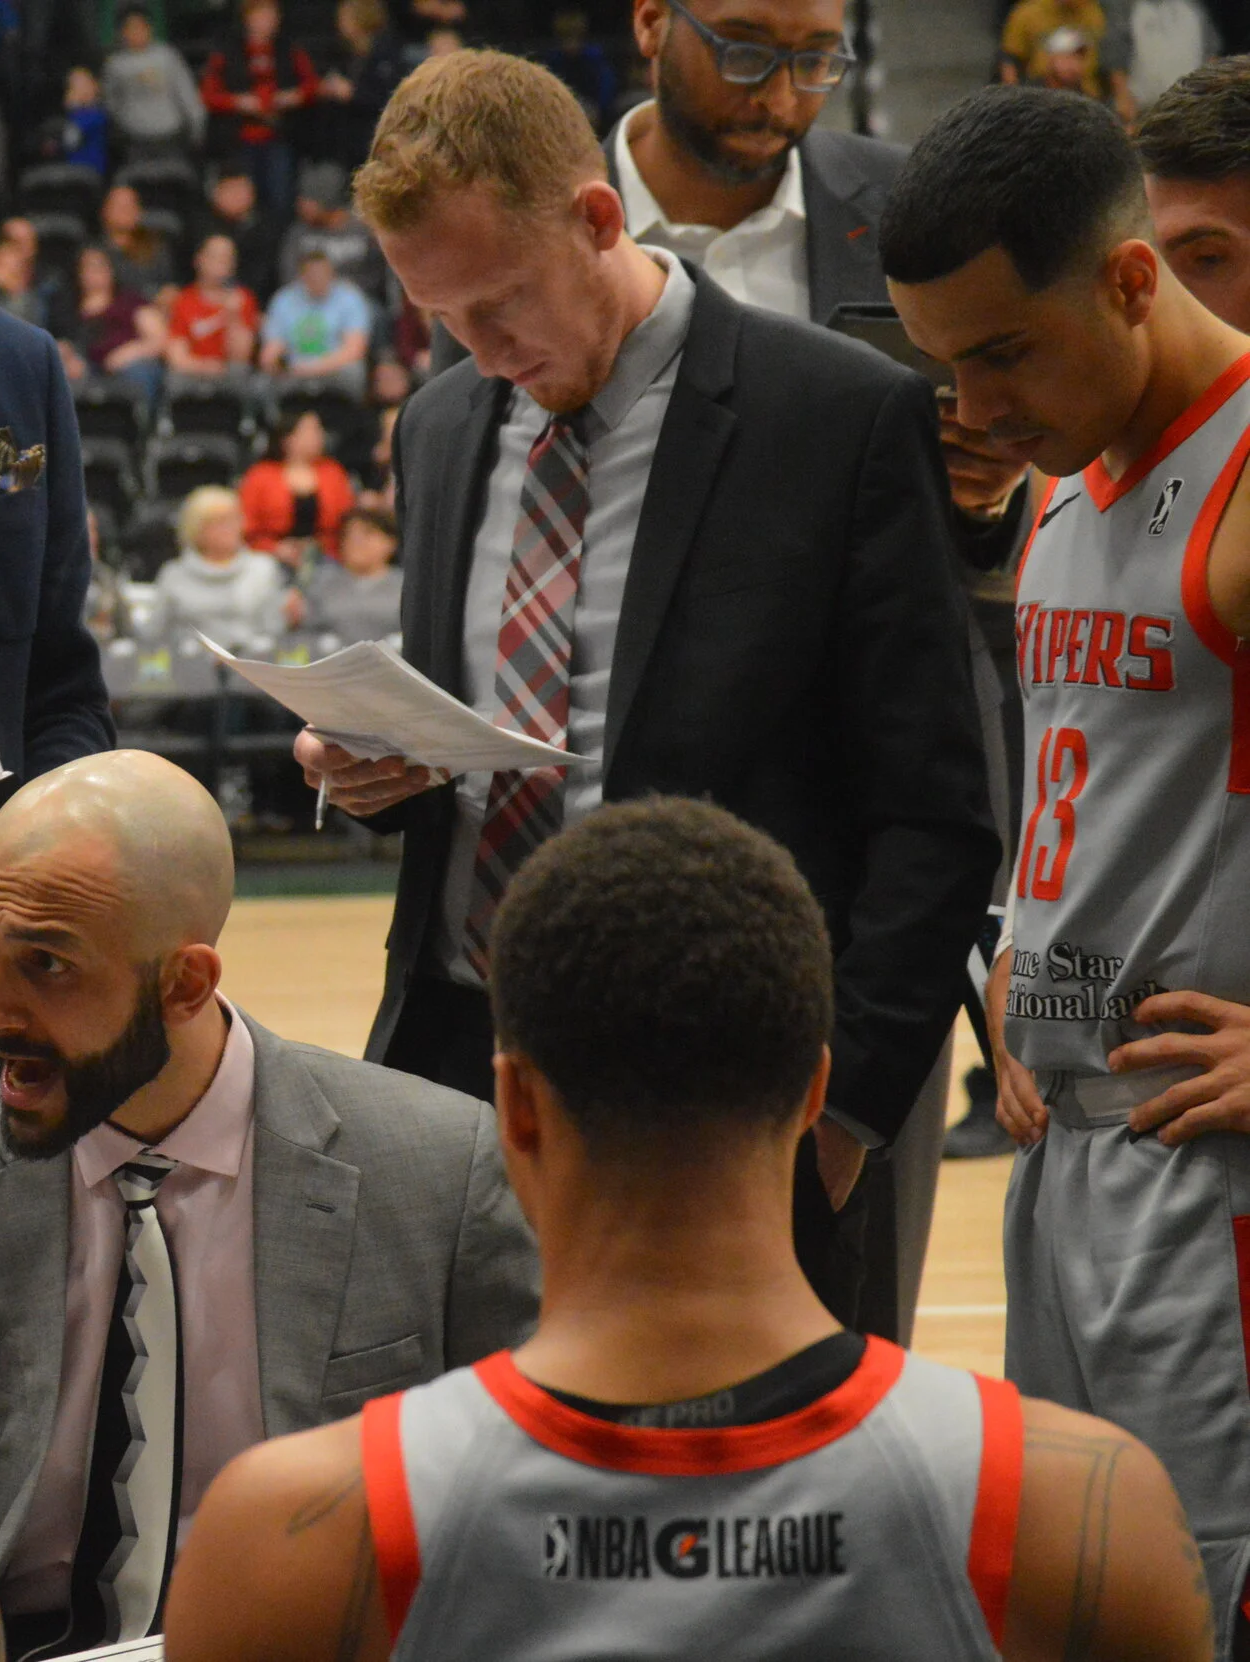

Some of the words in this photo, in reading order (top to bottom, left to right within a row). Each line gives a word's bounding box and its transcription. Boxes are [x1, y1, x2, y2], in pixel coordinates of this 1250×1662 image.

[1047, 941, 1123, 982] Star
[576, 1516, 652, 1580] NBA
[716, 1511, 848, 1578] LEAGUE
